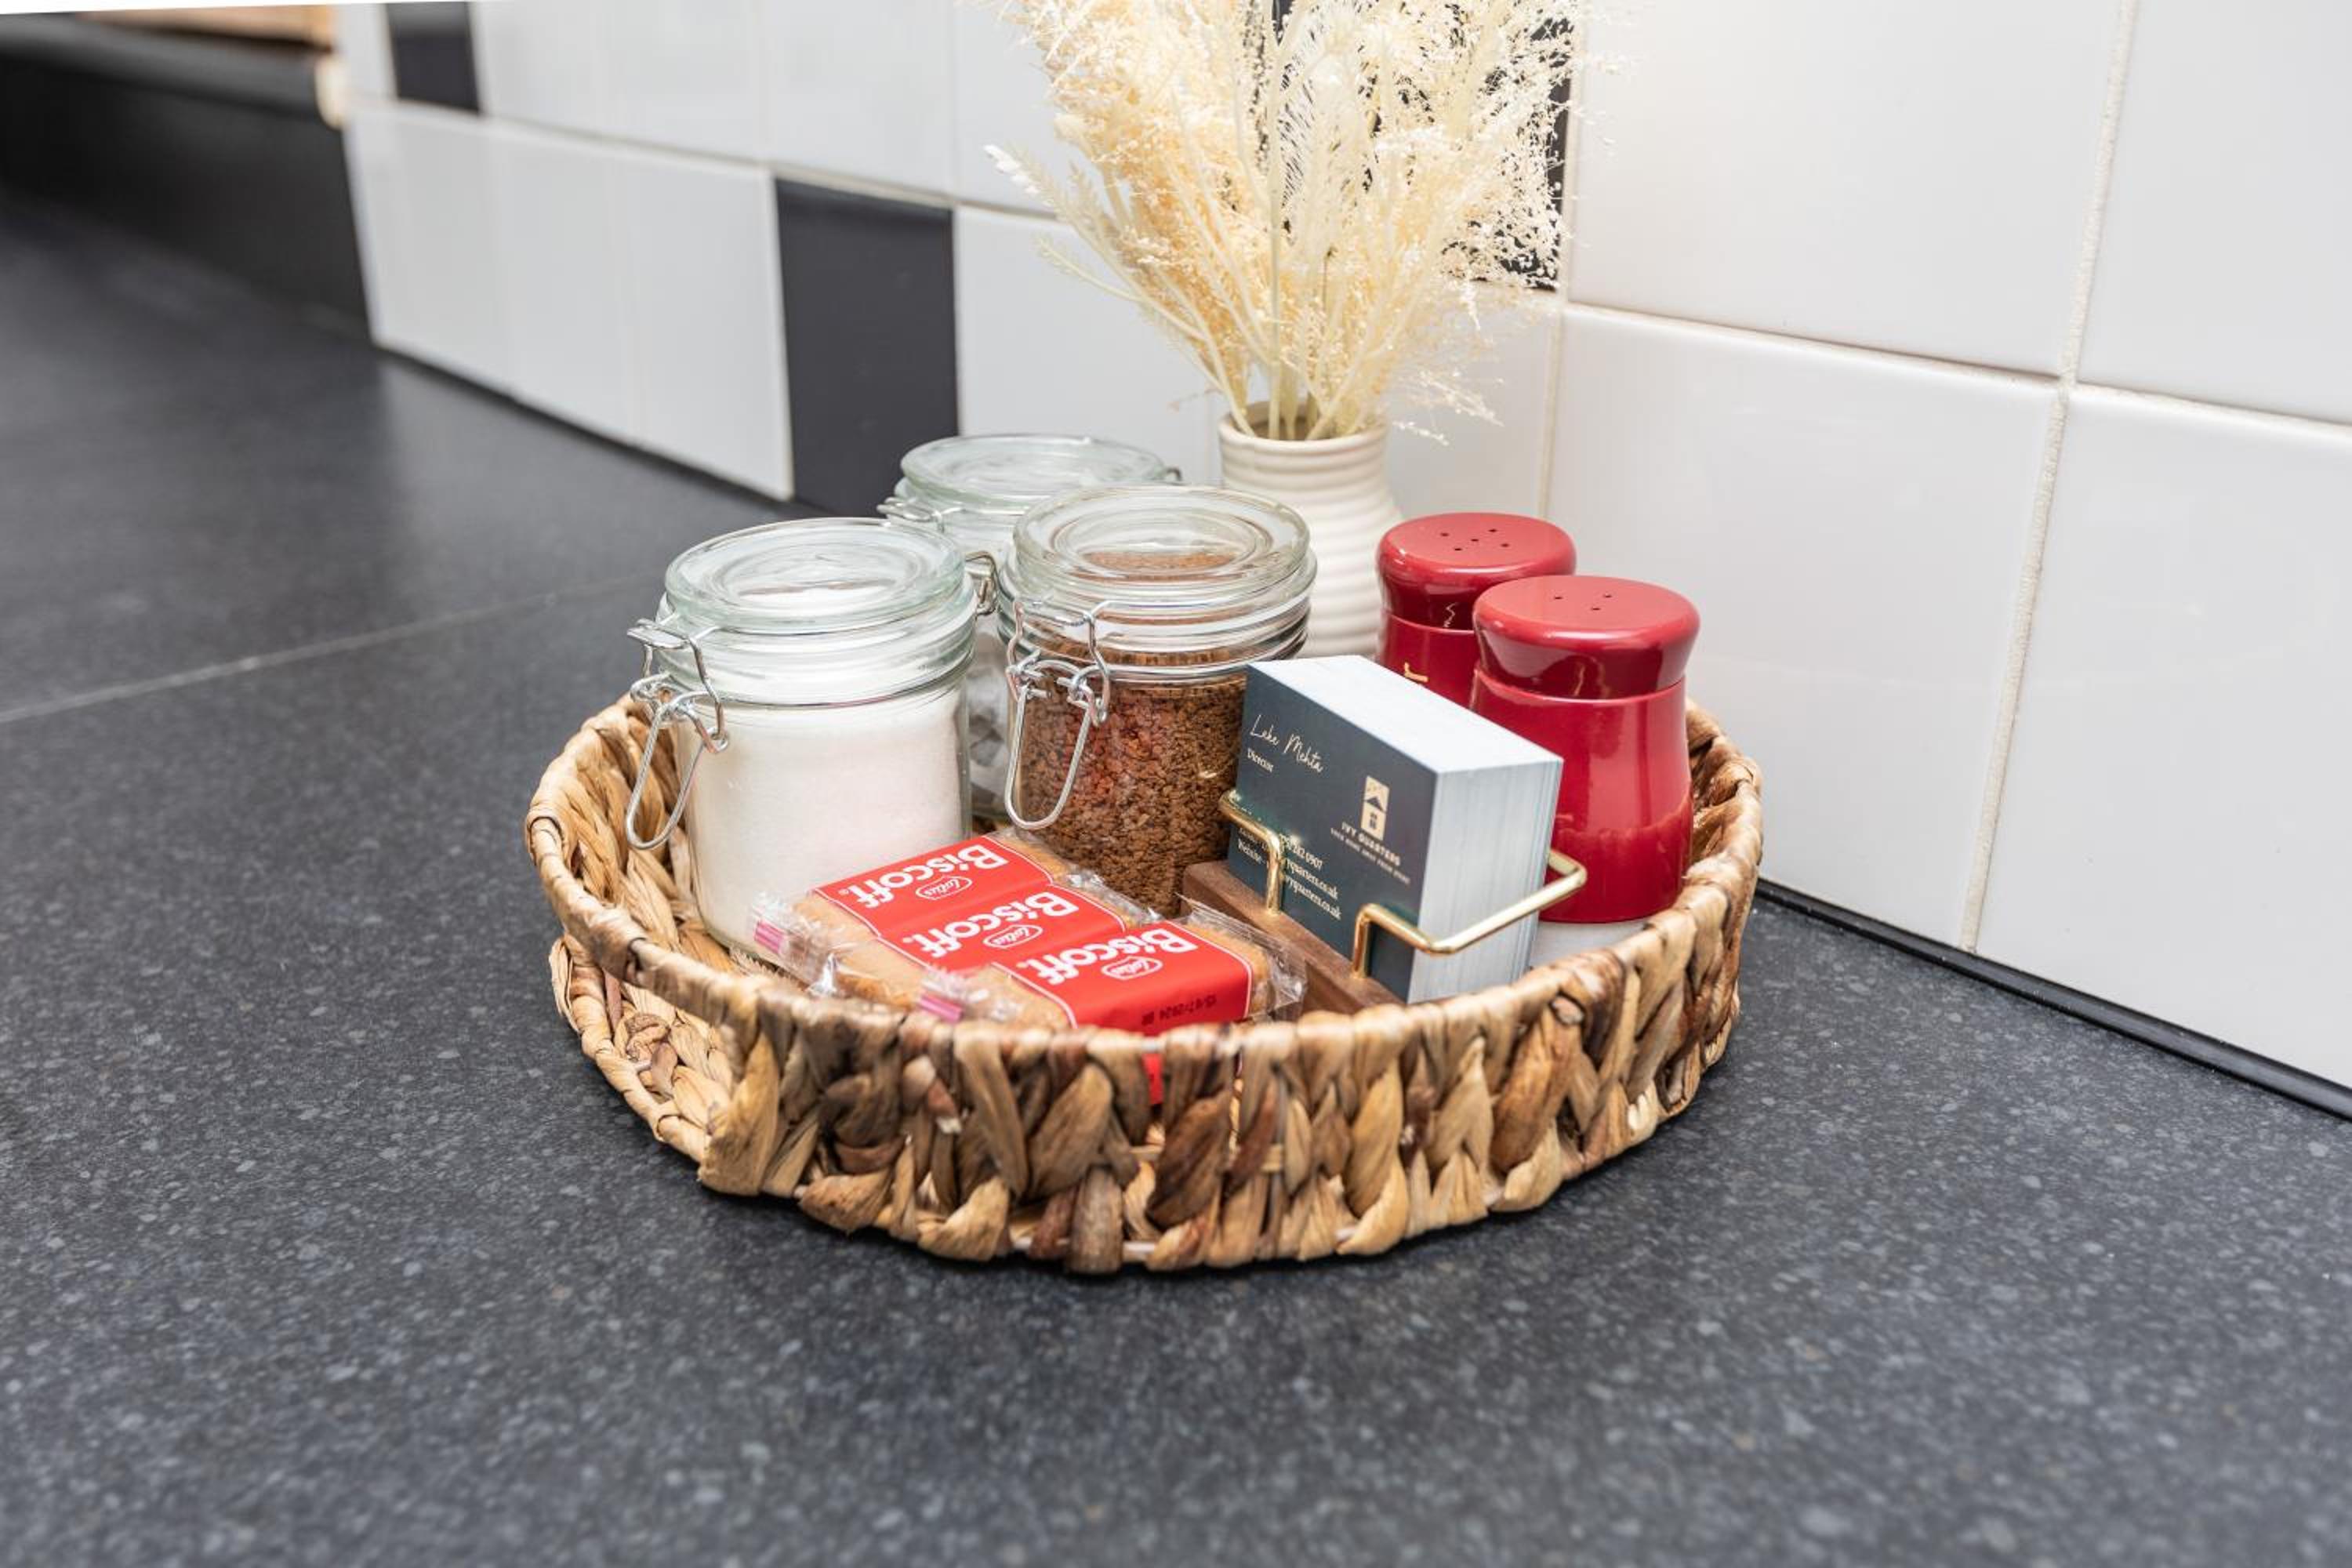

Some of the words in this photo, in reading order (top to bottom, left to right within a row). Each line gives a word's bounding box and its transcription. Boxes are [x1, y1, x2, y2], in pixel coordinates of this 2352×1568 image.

[848, 844, 1010, 909] Biscoff
[911, 891, 1080, 958] Biscoff
[1025, 927, 1199, 985] Biscoff
